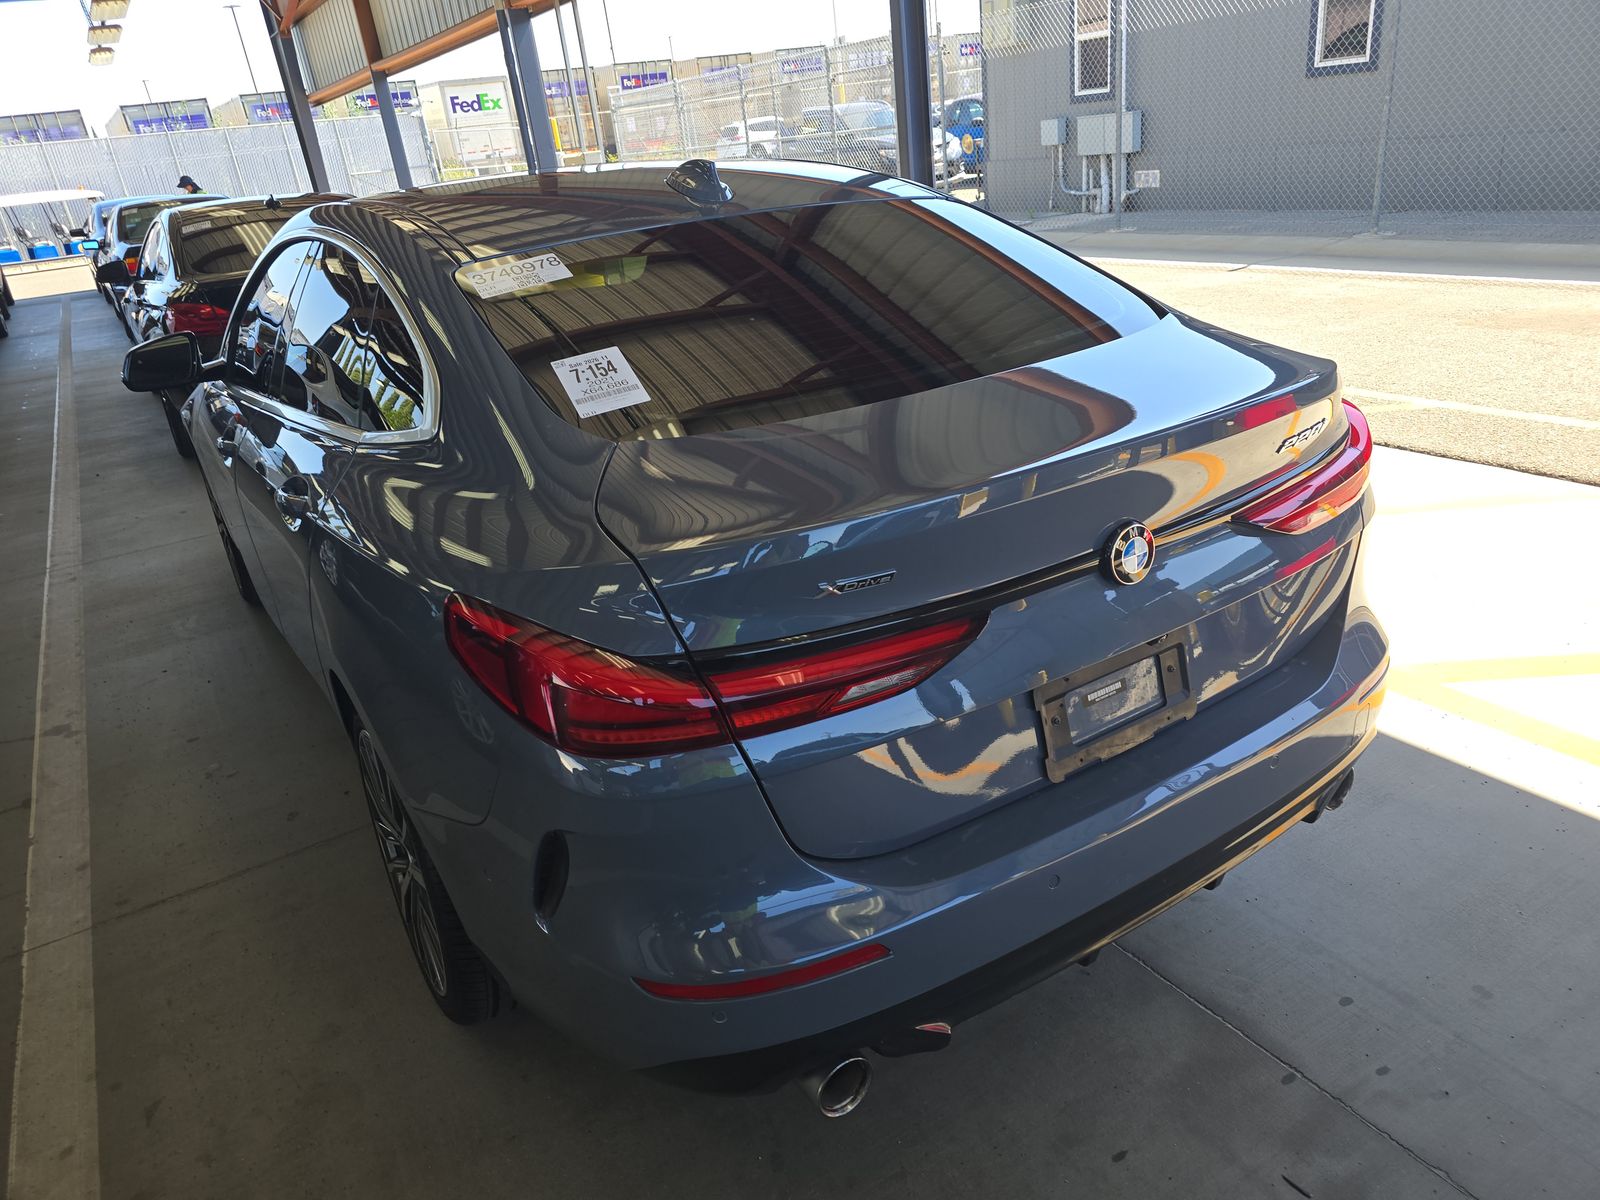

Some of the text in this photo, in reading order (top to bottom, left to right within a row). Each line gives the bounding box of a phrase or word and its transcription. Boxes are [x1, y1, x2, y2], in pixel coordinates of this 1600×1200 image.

[449, 93, 503, 113] FedEx
[472, 256, 561, 285] 3740978
[569, 359, 618, 384] 7:154
[587, 376, 615, 387] 2021
